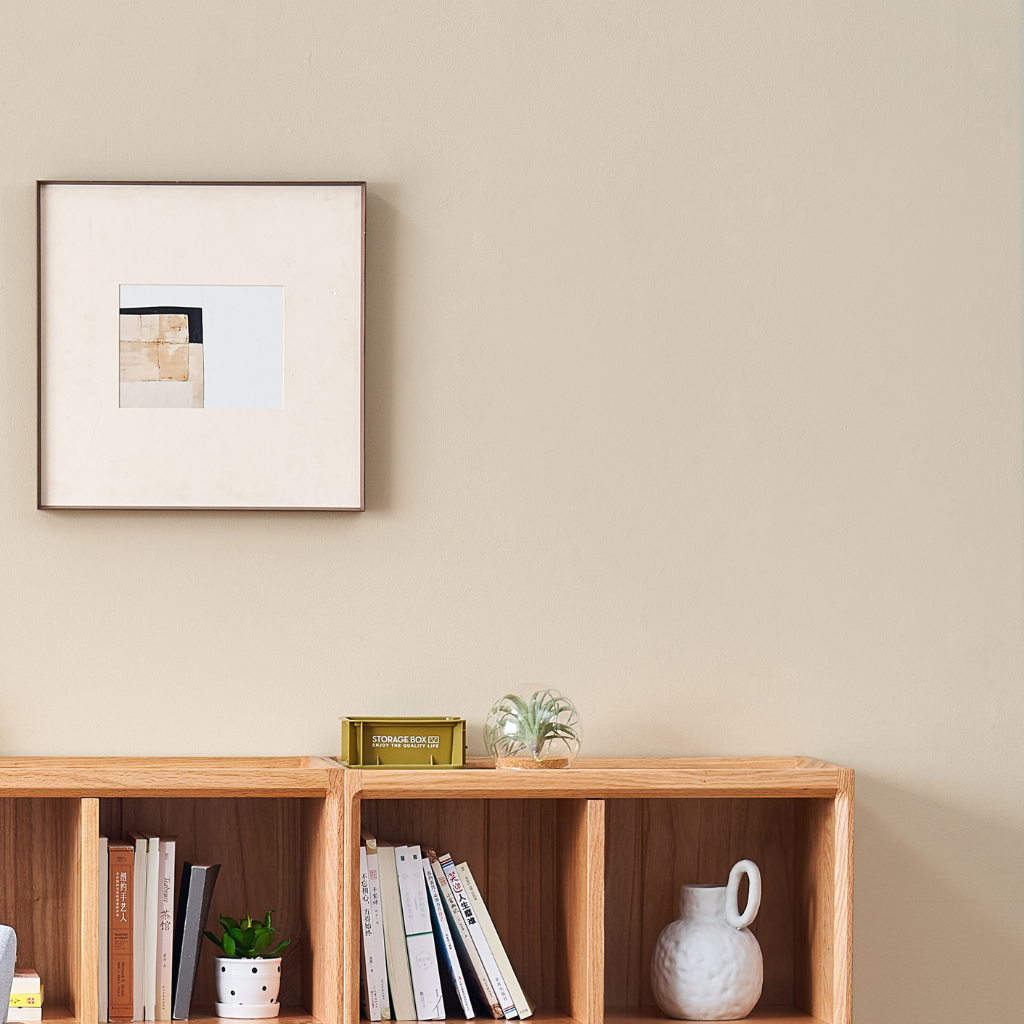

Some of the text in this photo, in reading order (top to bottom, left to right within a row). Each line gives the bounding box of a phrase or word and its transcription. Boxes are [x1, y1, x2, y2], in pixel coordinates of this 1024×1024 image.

[372, 736, 426, 744] STORAGE BOX
[448, 871, 477, 926] 笑迎人生磨难
[160, 909, 171, 931] 茶馆
